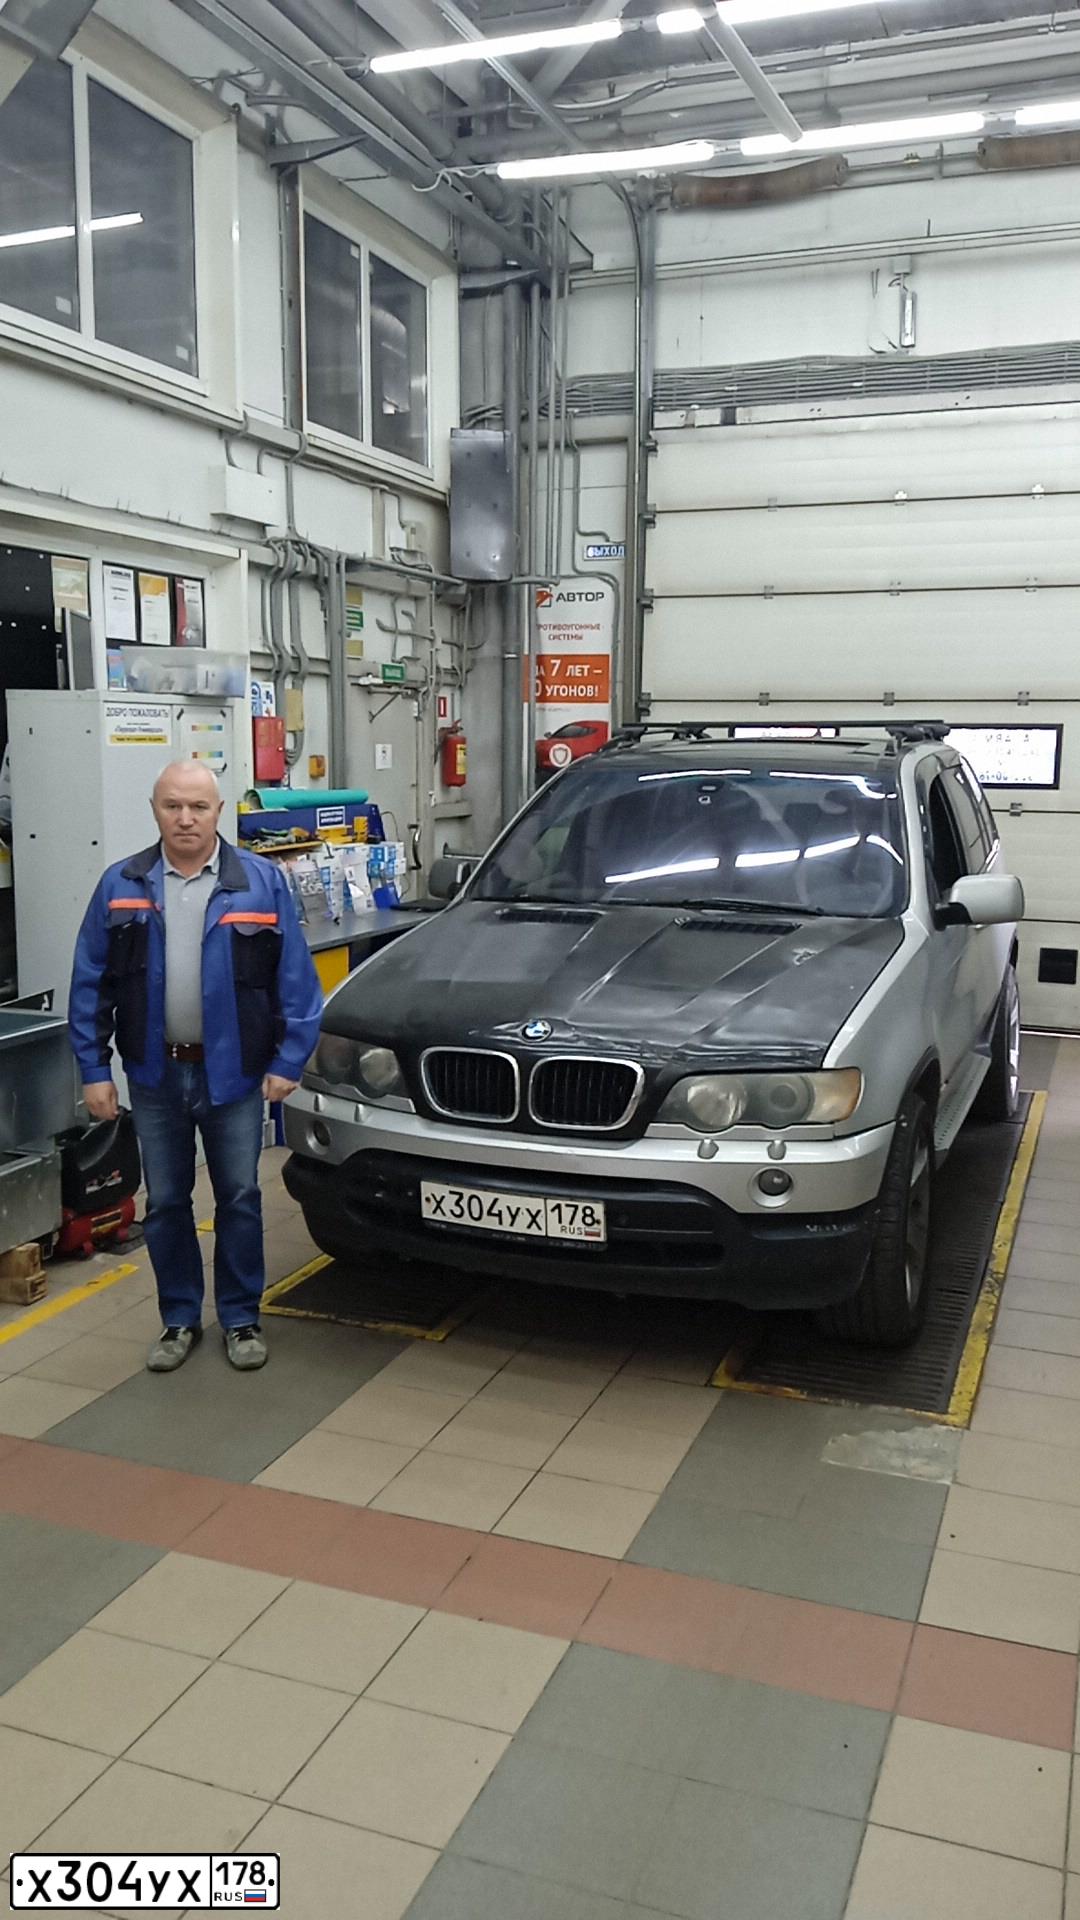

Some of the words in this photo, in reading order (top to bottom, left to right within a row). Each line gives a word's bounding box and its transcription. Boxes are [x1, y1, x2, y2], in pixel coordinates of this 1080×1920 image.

[556, 591, 605, 603] АВТОР
[535, 623, 601, 631] РОТИВОУГОННЫЕ
[548, 633, 584, 641] СИСТЕМЫ
[550, 658, 561, 677] 7
[565, 664, 590, 677] ЛЕТ
[545, 684, 599, 697] УГОНОВ!
[551, 1203, 596, 1227] 178
[560, 1225, 584, 1237] RUS
